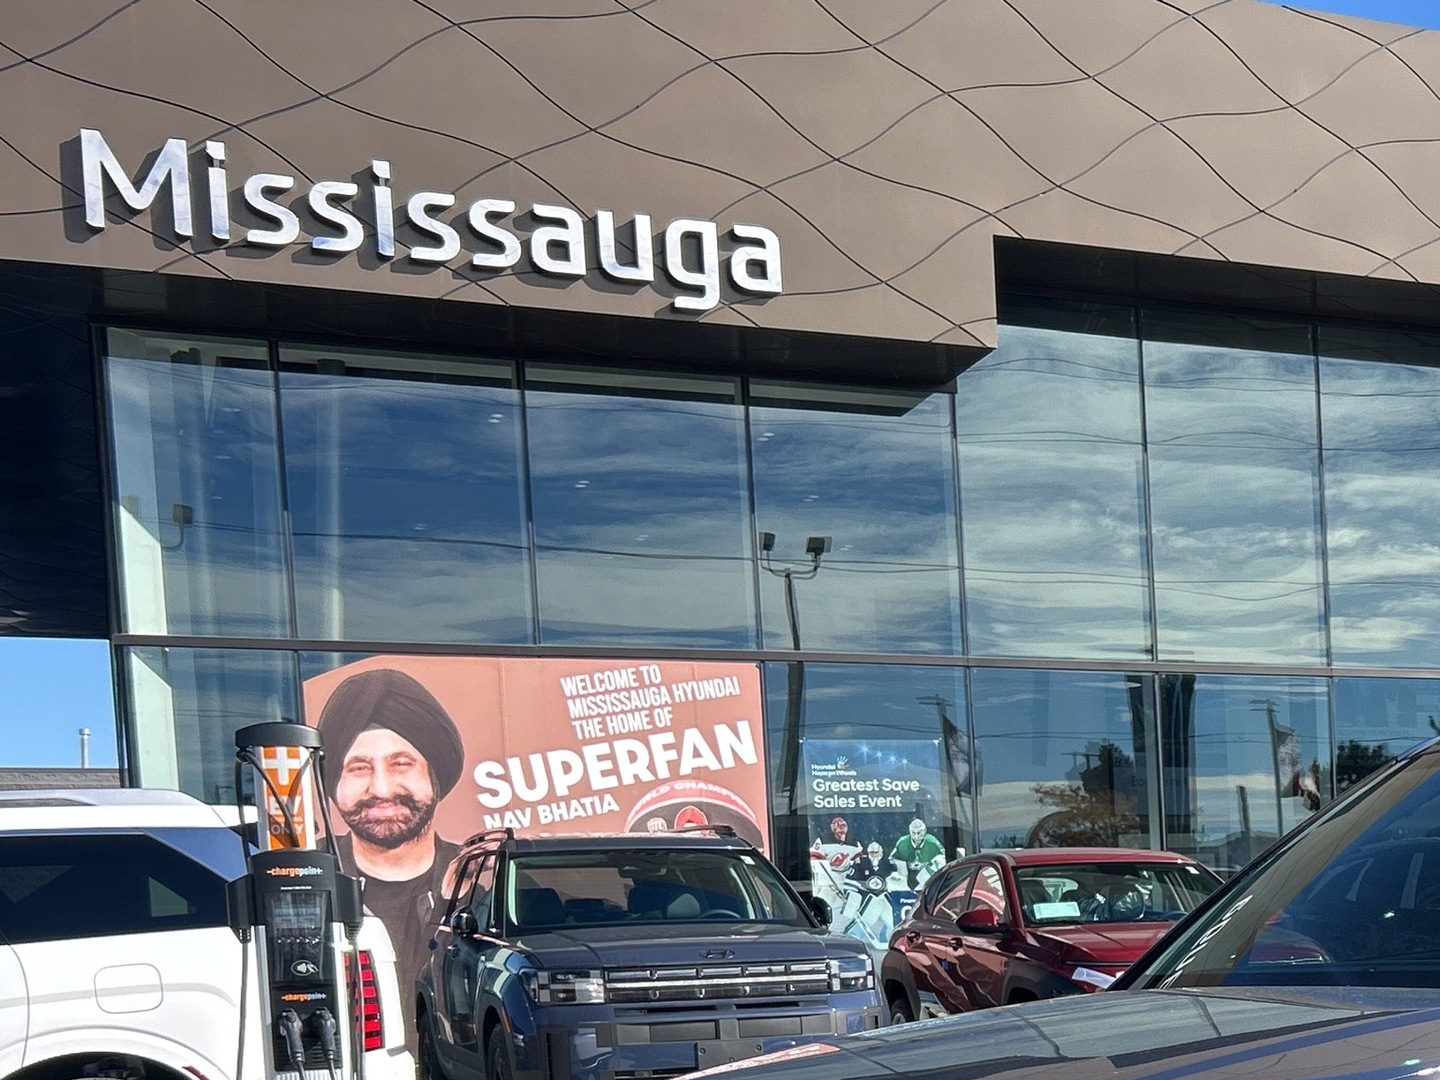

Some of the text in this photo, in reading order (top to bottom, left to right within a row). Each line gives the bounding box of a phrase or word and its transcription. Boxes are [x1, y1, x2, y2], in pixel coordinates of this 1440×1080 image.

[79, 128, 782, 309] Mississauga
[560, 664, 662, 698] WELCOME TO
[566, 676, 741, 719] MISSISSAUGA HYUNDAI
[572, 707, 673, 741] THE HOME OF
[473, 720, 759, 809] SUPERFAN
[813, 778, 920, 792] Greatest Save
[813, 794, 902, 808] Sales Event
[483, 793, 620, 830] NAV BHATIA
